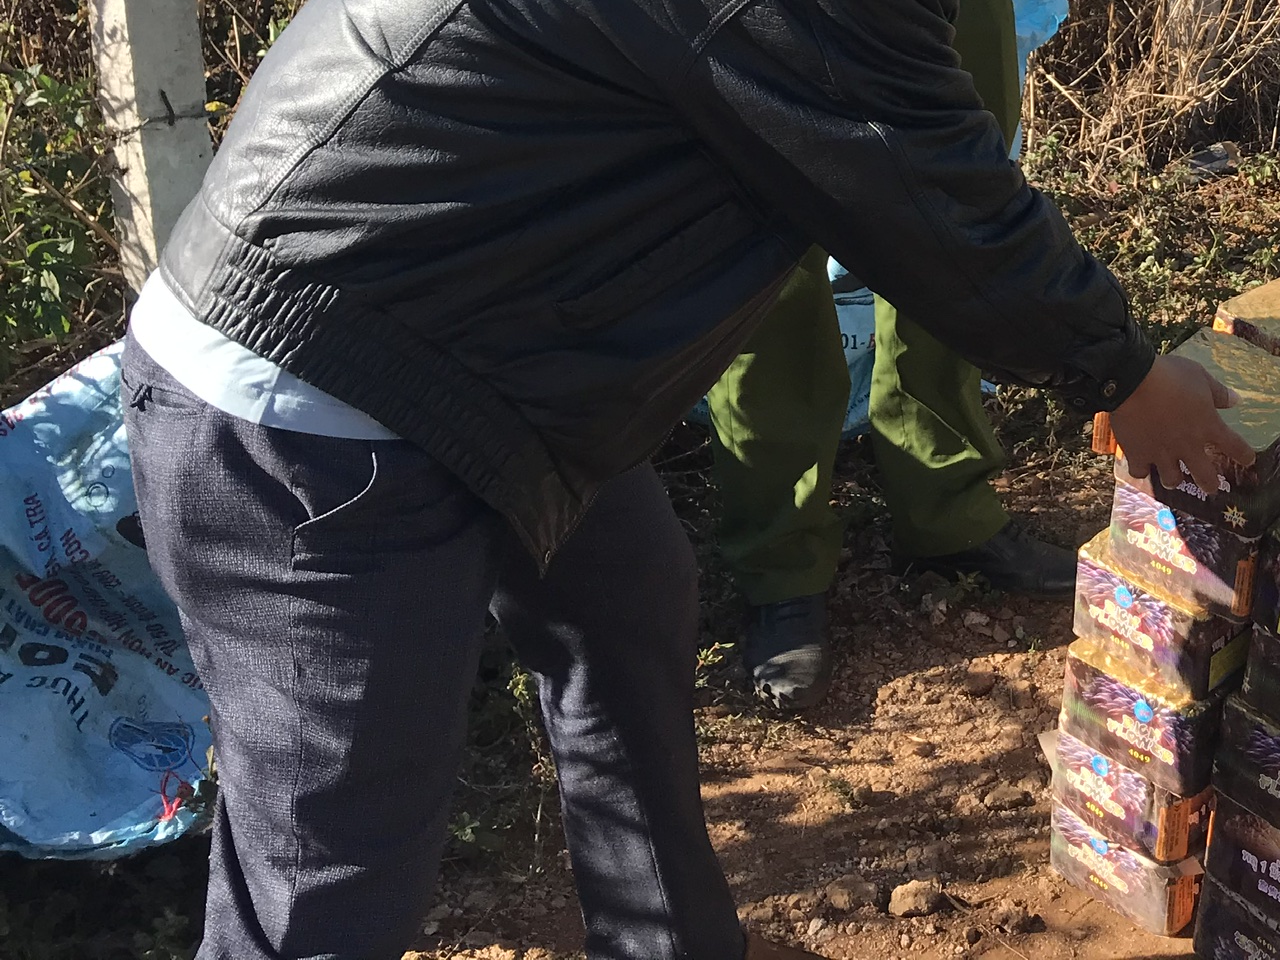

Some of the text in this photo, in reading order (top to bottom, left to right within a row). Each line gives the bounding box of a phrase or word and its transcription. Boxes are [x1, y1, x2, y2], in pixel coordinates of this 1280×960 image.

[23, 492, 46, 529] TRA
[1126, 528, 1198, 575] FLOWER
[1150, 560, 1172, 576] 4049
[1089, 603, 1154, 652] FLOWER
[1106, 717, 1175, 766] FLOWER
[1128, 748, 1151, 763] 4049
[1260, 860, 1267, 874] 1
